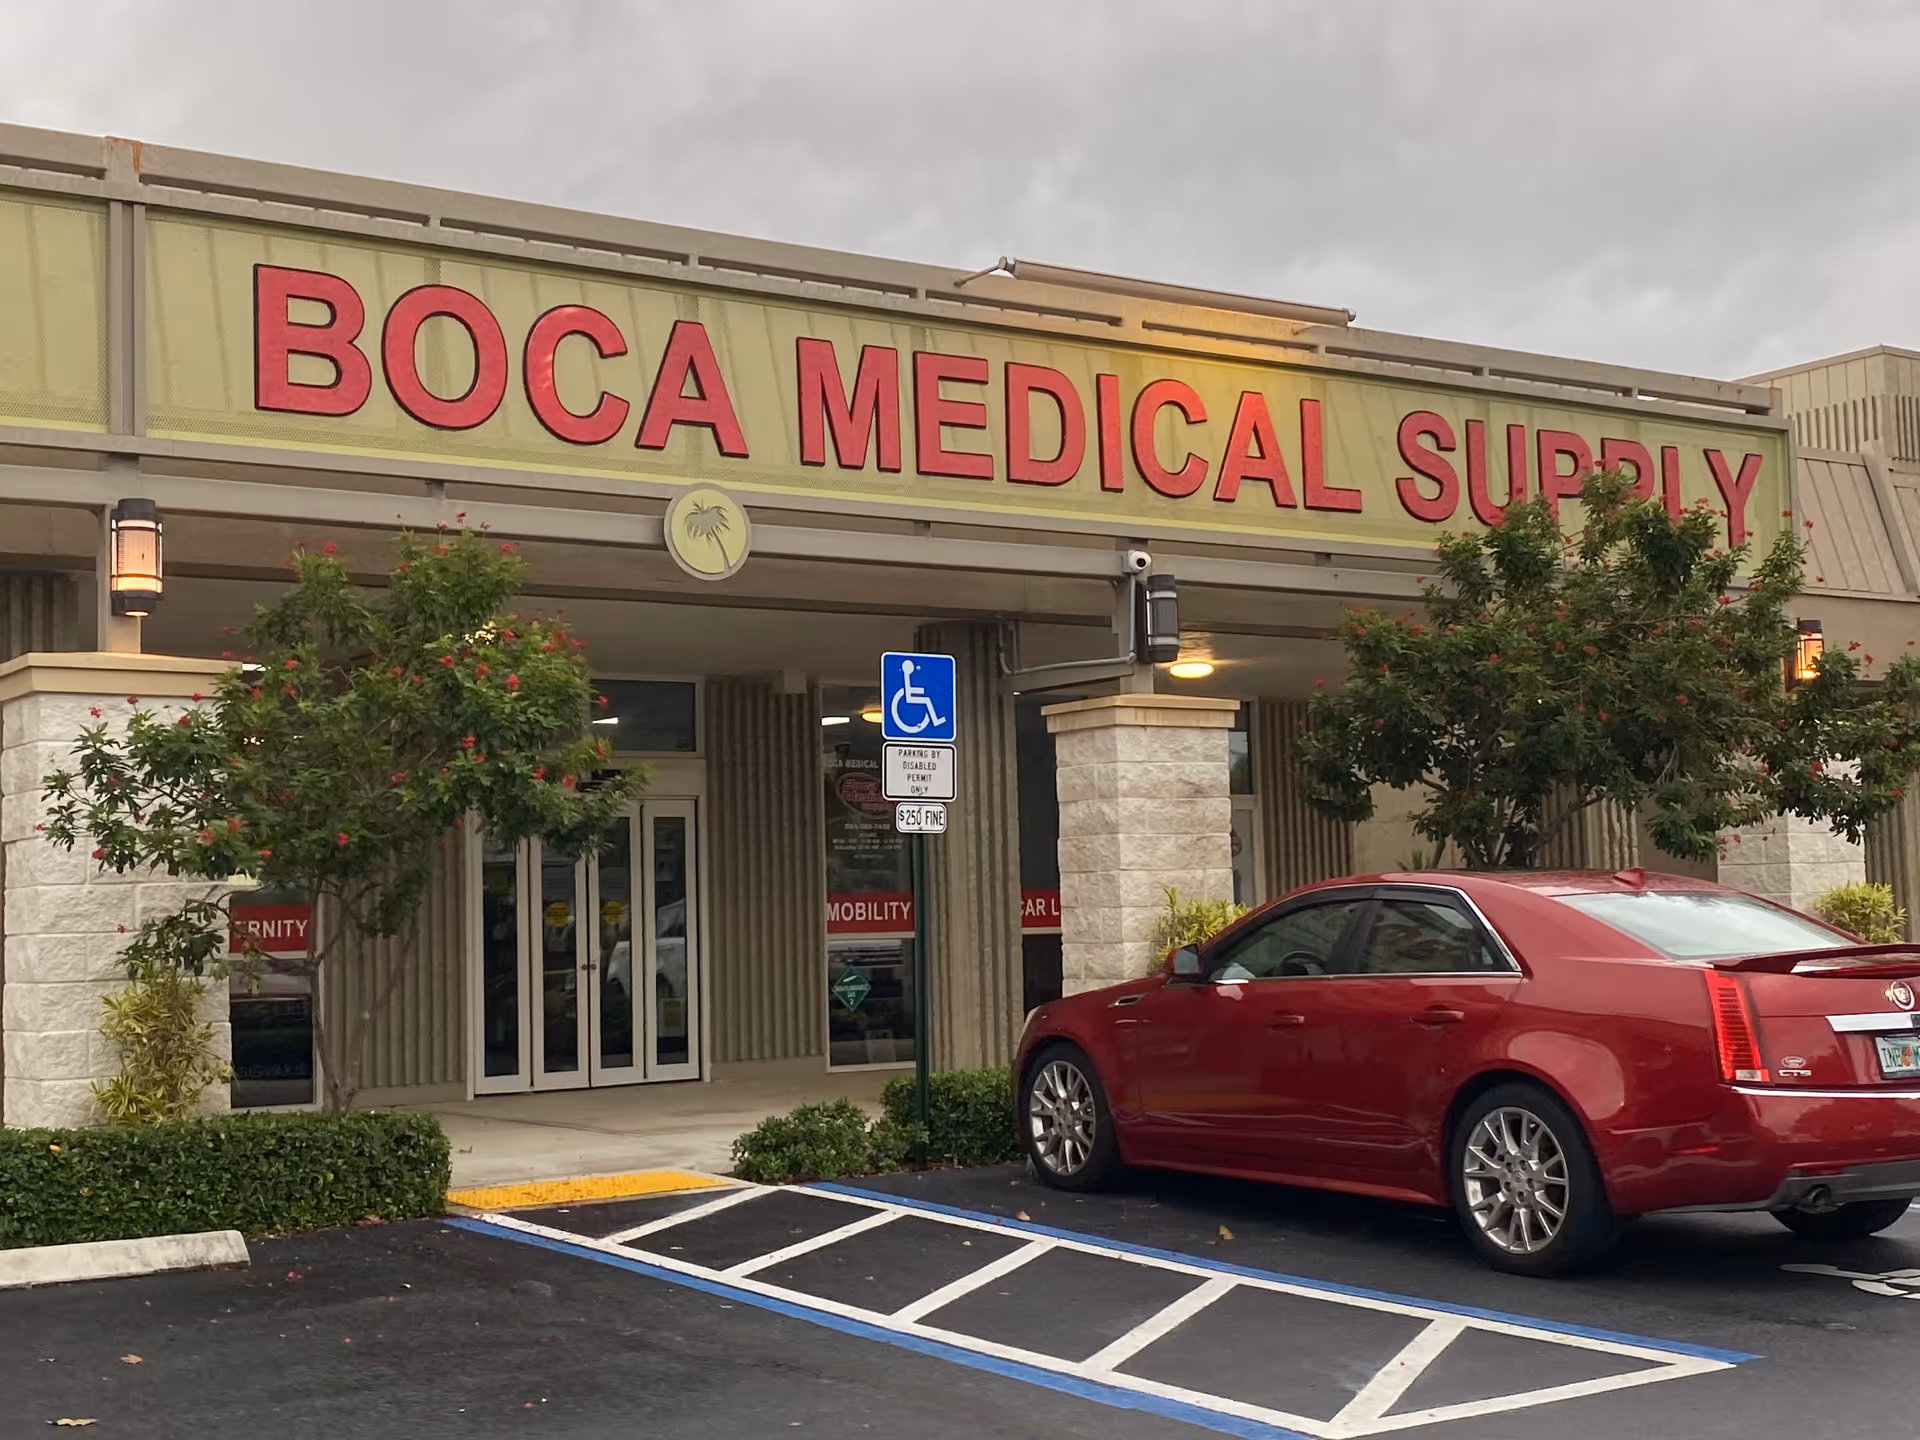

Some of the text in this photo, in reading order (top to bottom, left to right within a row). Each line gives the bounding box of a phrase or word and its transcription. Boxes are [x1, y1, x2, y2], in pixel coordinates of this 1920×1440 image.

[253, 264, 1763, 549] BOCA MEDICAL SUPPLY
[898, 748, 941, 759] PARKING BY
[845, 758, 879, 769] MEDICAL
[902, 761, 937, 771] DISABLED
[907, 773, 932, 783] PERMIT
[910, 785, 929, 795] ONLY
[898, 809, 944, 826] $250 FINE
[825, 901, 912, 921] MOBILITY
